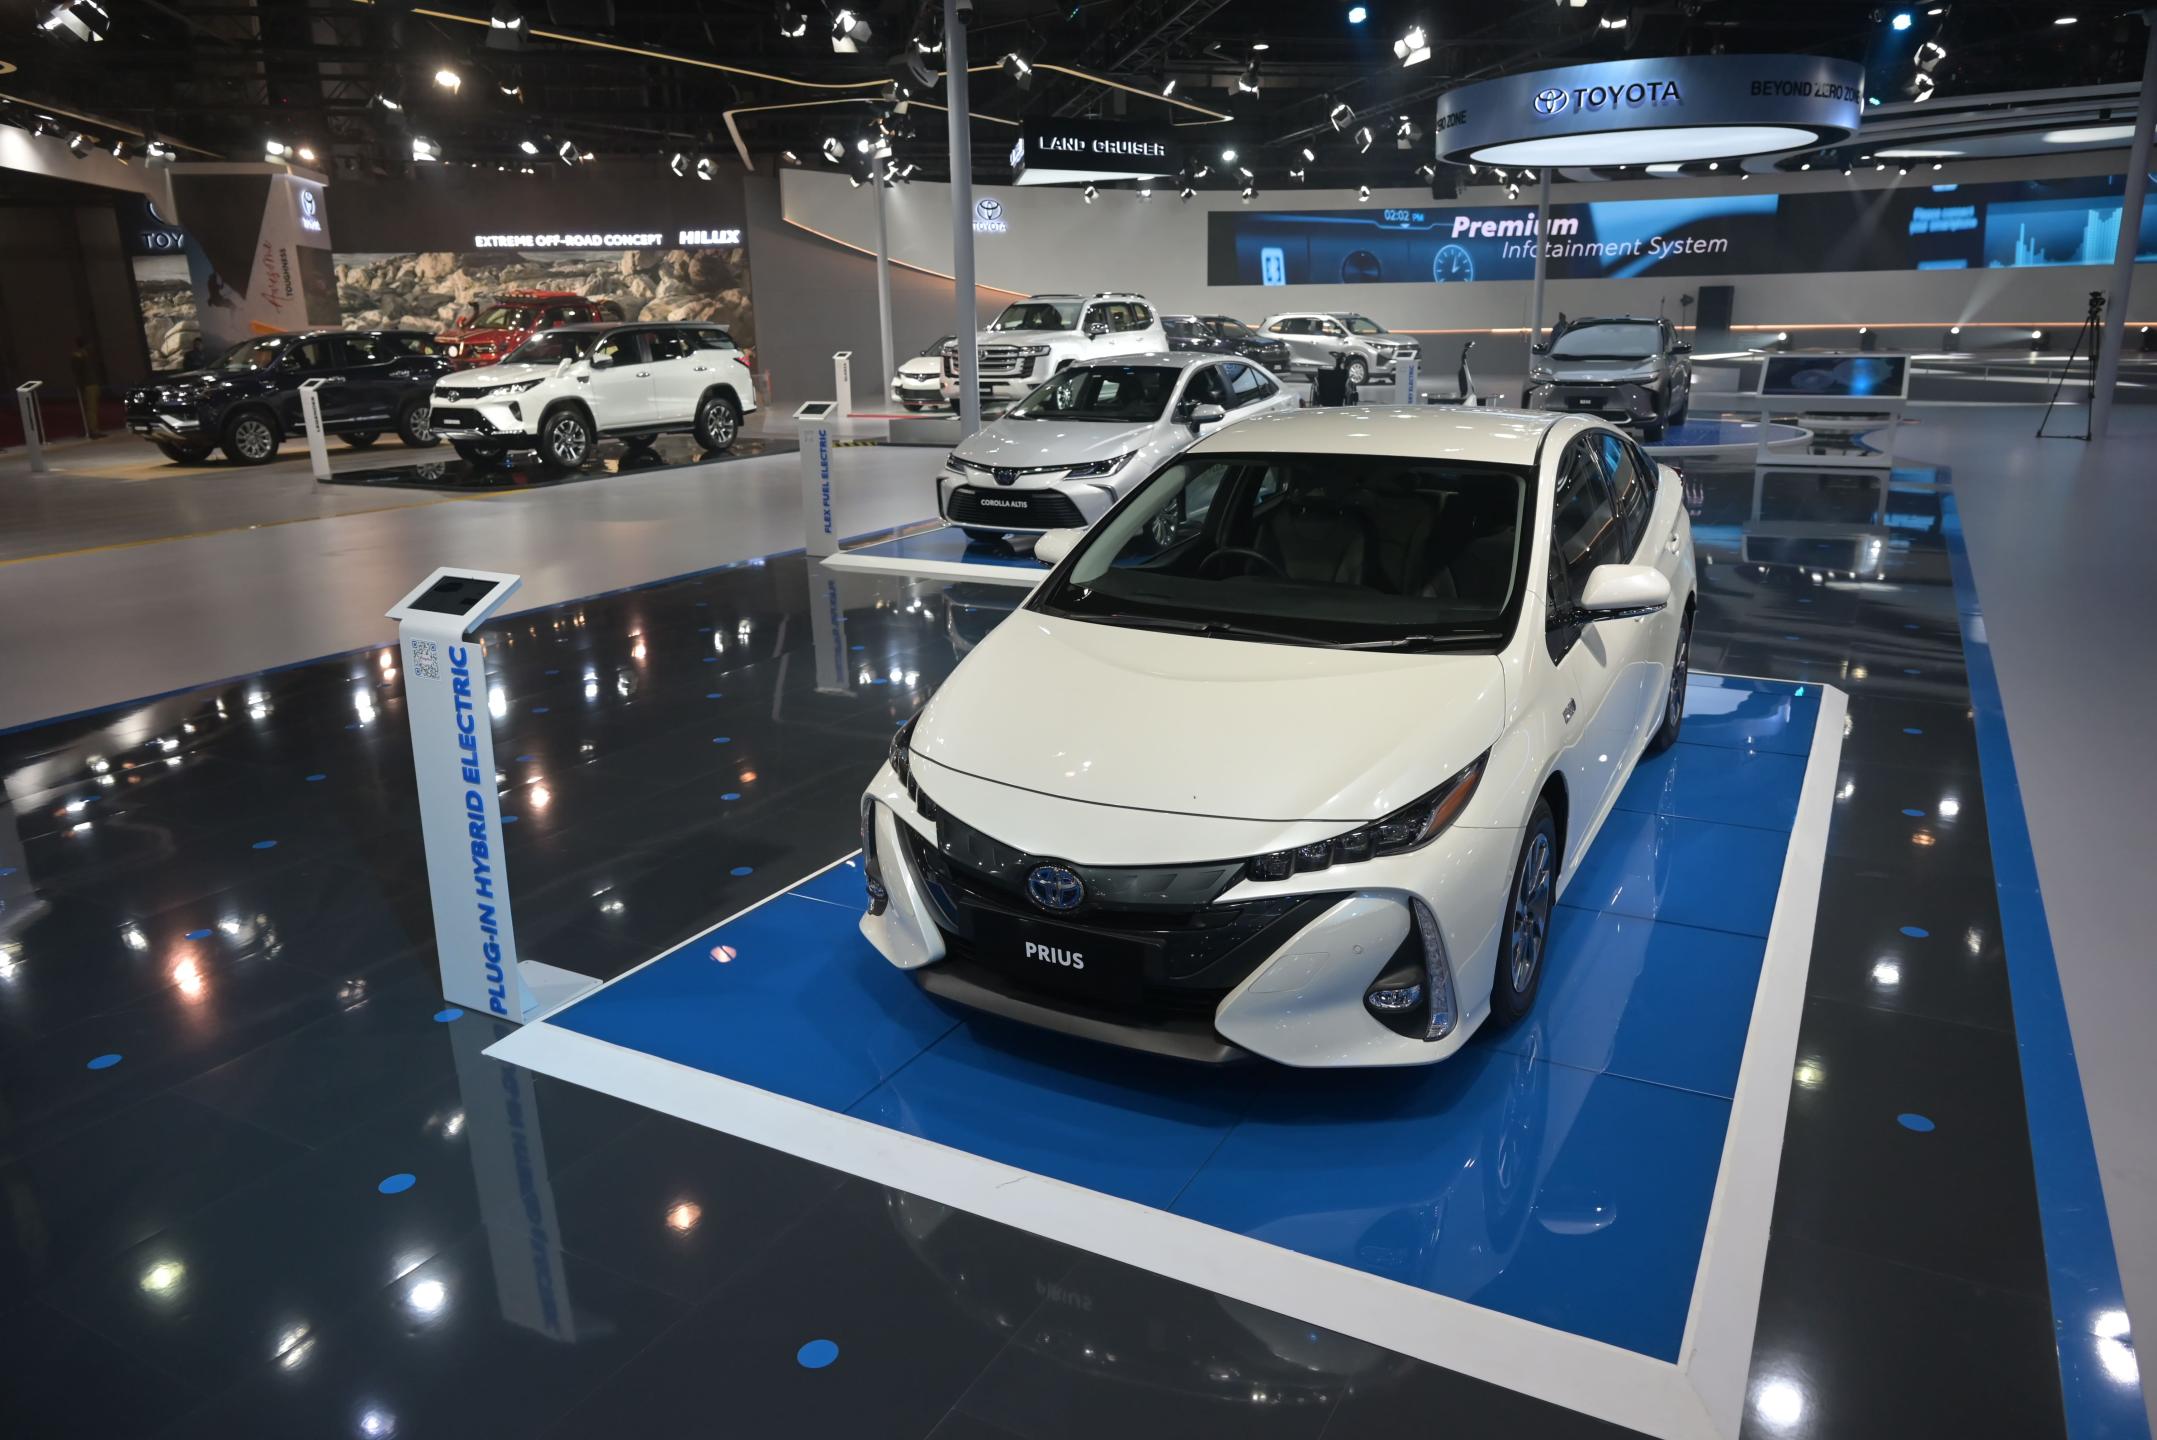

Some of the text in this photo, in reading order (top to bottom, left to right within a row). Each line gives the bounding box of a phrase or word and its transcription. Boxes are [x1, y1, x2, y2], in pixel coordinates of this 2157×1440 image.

[1573, 80, 1681, 109] TOYOTA
[1750, 80, 1813, 97] BEYOND
[1039, 136, 1165, 156] LAND CRUISER
[1384, 209, 1425, 222] 02:02 PM
[972, 221, 1008, 232] TOYOTA
[142, 231, 184, 249] TOY
[475, 233, 663, 248] EXTREME OFF-ROAD CONCEPT
[678, 229, 741, 245] HILUX
[1647, 235, 1729, 259] System
[818, 429, 832, 534] FLEX FUEL ELECTRIC
[980, 499, 1028, 508] COROLLA ALTIS
[448, 645, 508, 1016] PLUG-IN HYBRID ELECTRIC
[1025, 941, 1085, 970] PRIUS
